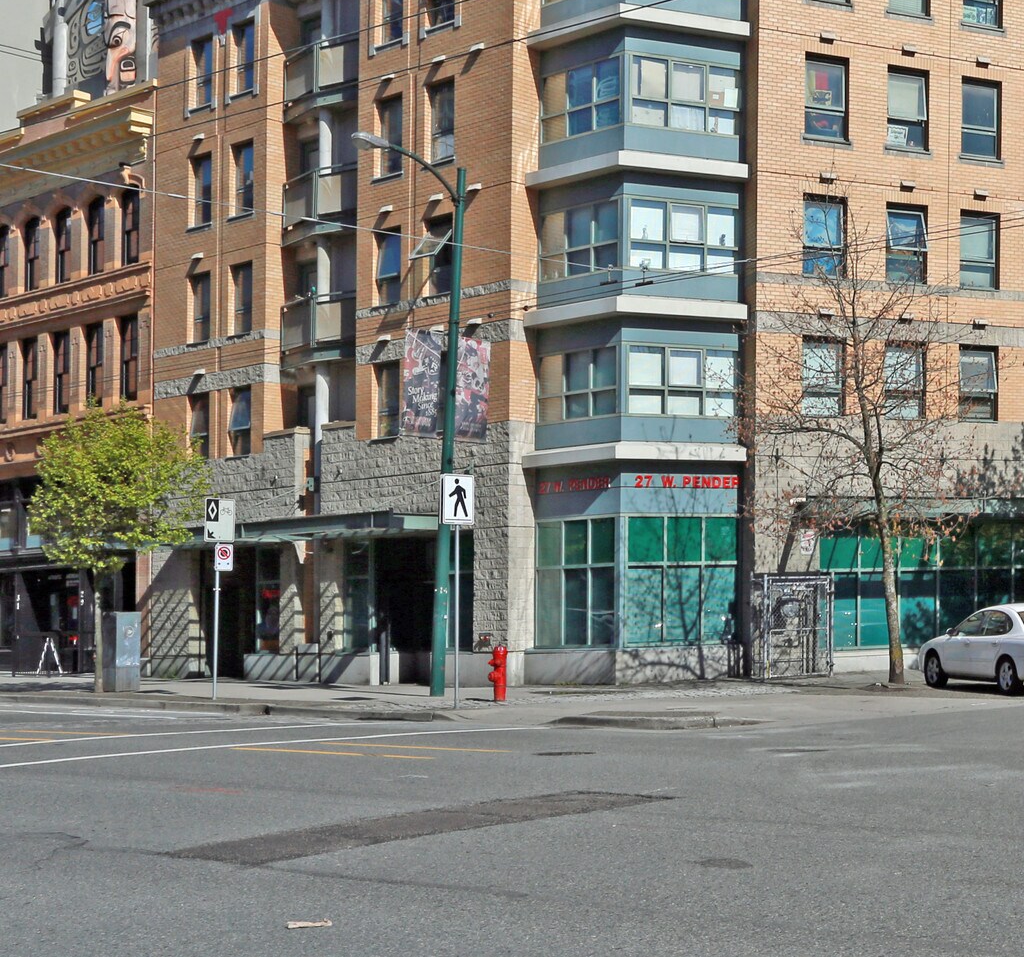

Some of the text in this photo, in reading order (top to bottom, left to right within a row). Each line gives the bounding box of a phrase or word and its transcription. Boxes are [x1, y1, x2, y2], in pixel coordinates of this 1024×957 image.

[407, 386, 425, 396] Story
[412, 391, 438, 403] Making
[418, 401, 434, 411] Since
[538, 481, 551, 494] 27
[634, 475, 653, 488] 27
[661, 475, 677, 489] W.
